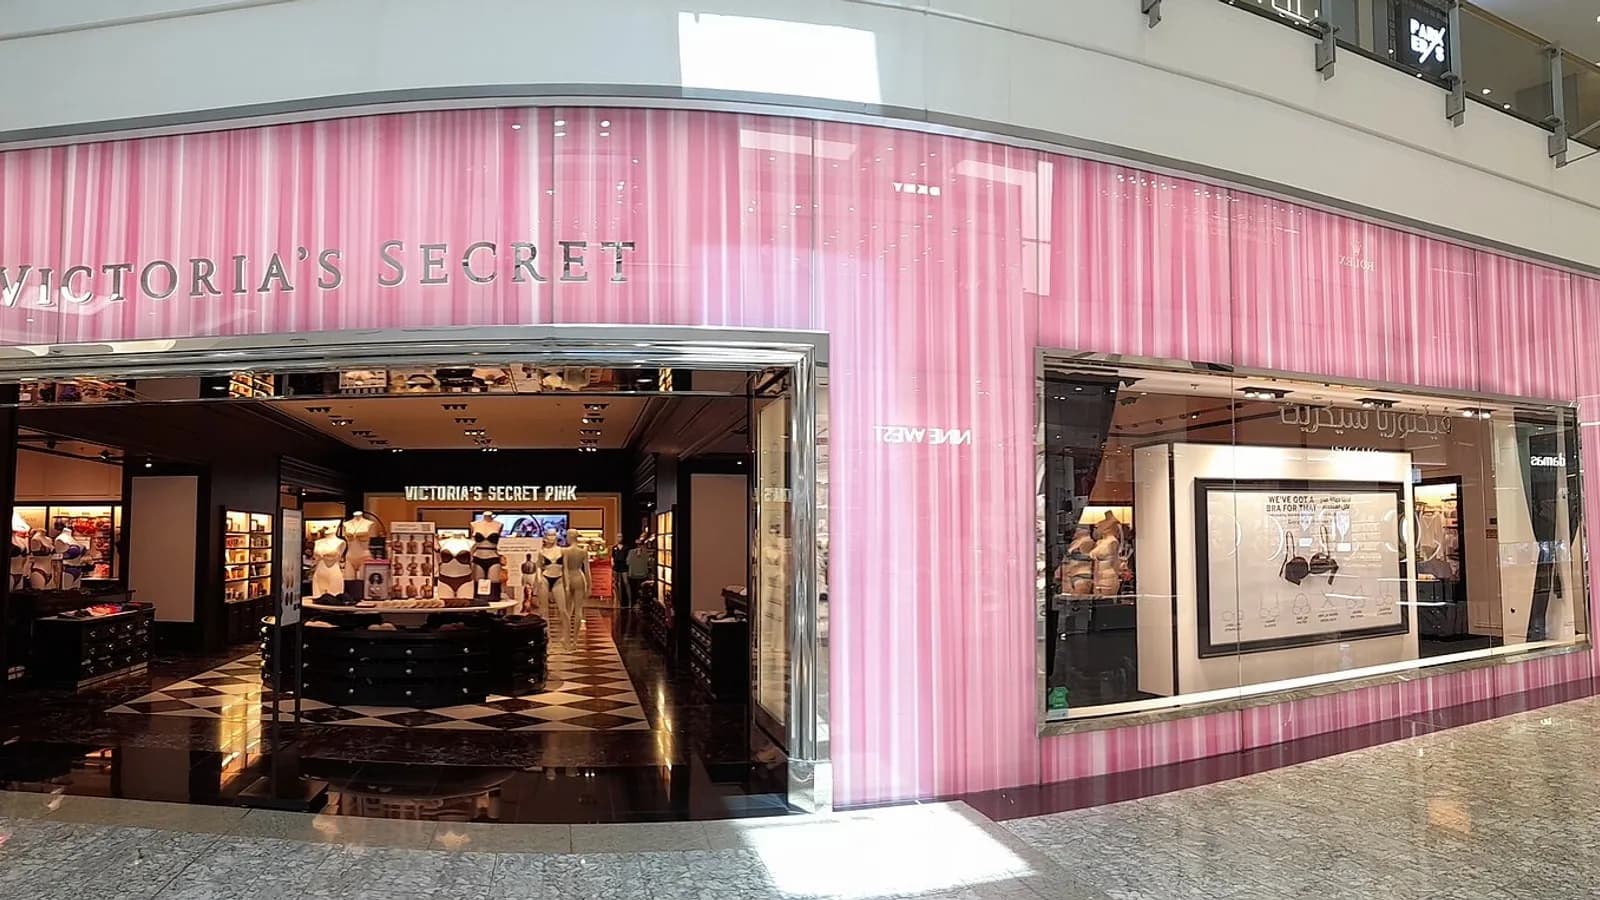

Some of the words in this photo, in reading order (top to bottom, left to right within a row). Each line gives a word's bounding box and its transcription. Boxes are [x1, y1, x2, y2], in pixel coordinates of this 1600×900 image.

[0, 246, 342, 308] VICTORIA'S
[378, 239, 636, 289] SECRET
[404, 485, 483, 501] VICTORIA'S
[488, 485, 540, 501] SECRET
[544, 485, 577, 501] PINK
[1283, 504, 1297, 512] FOR
